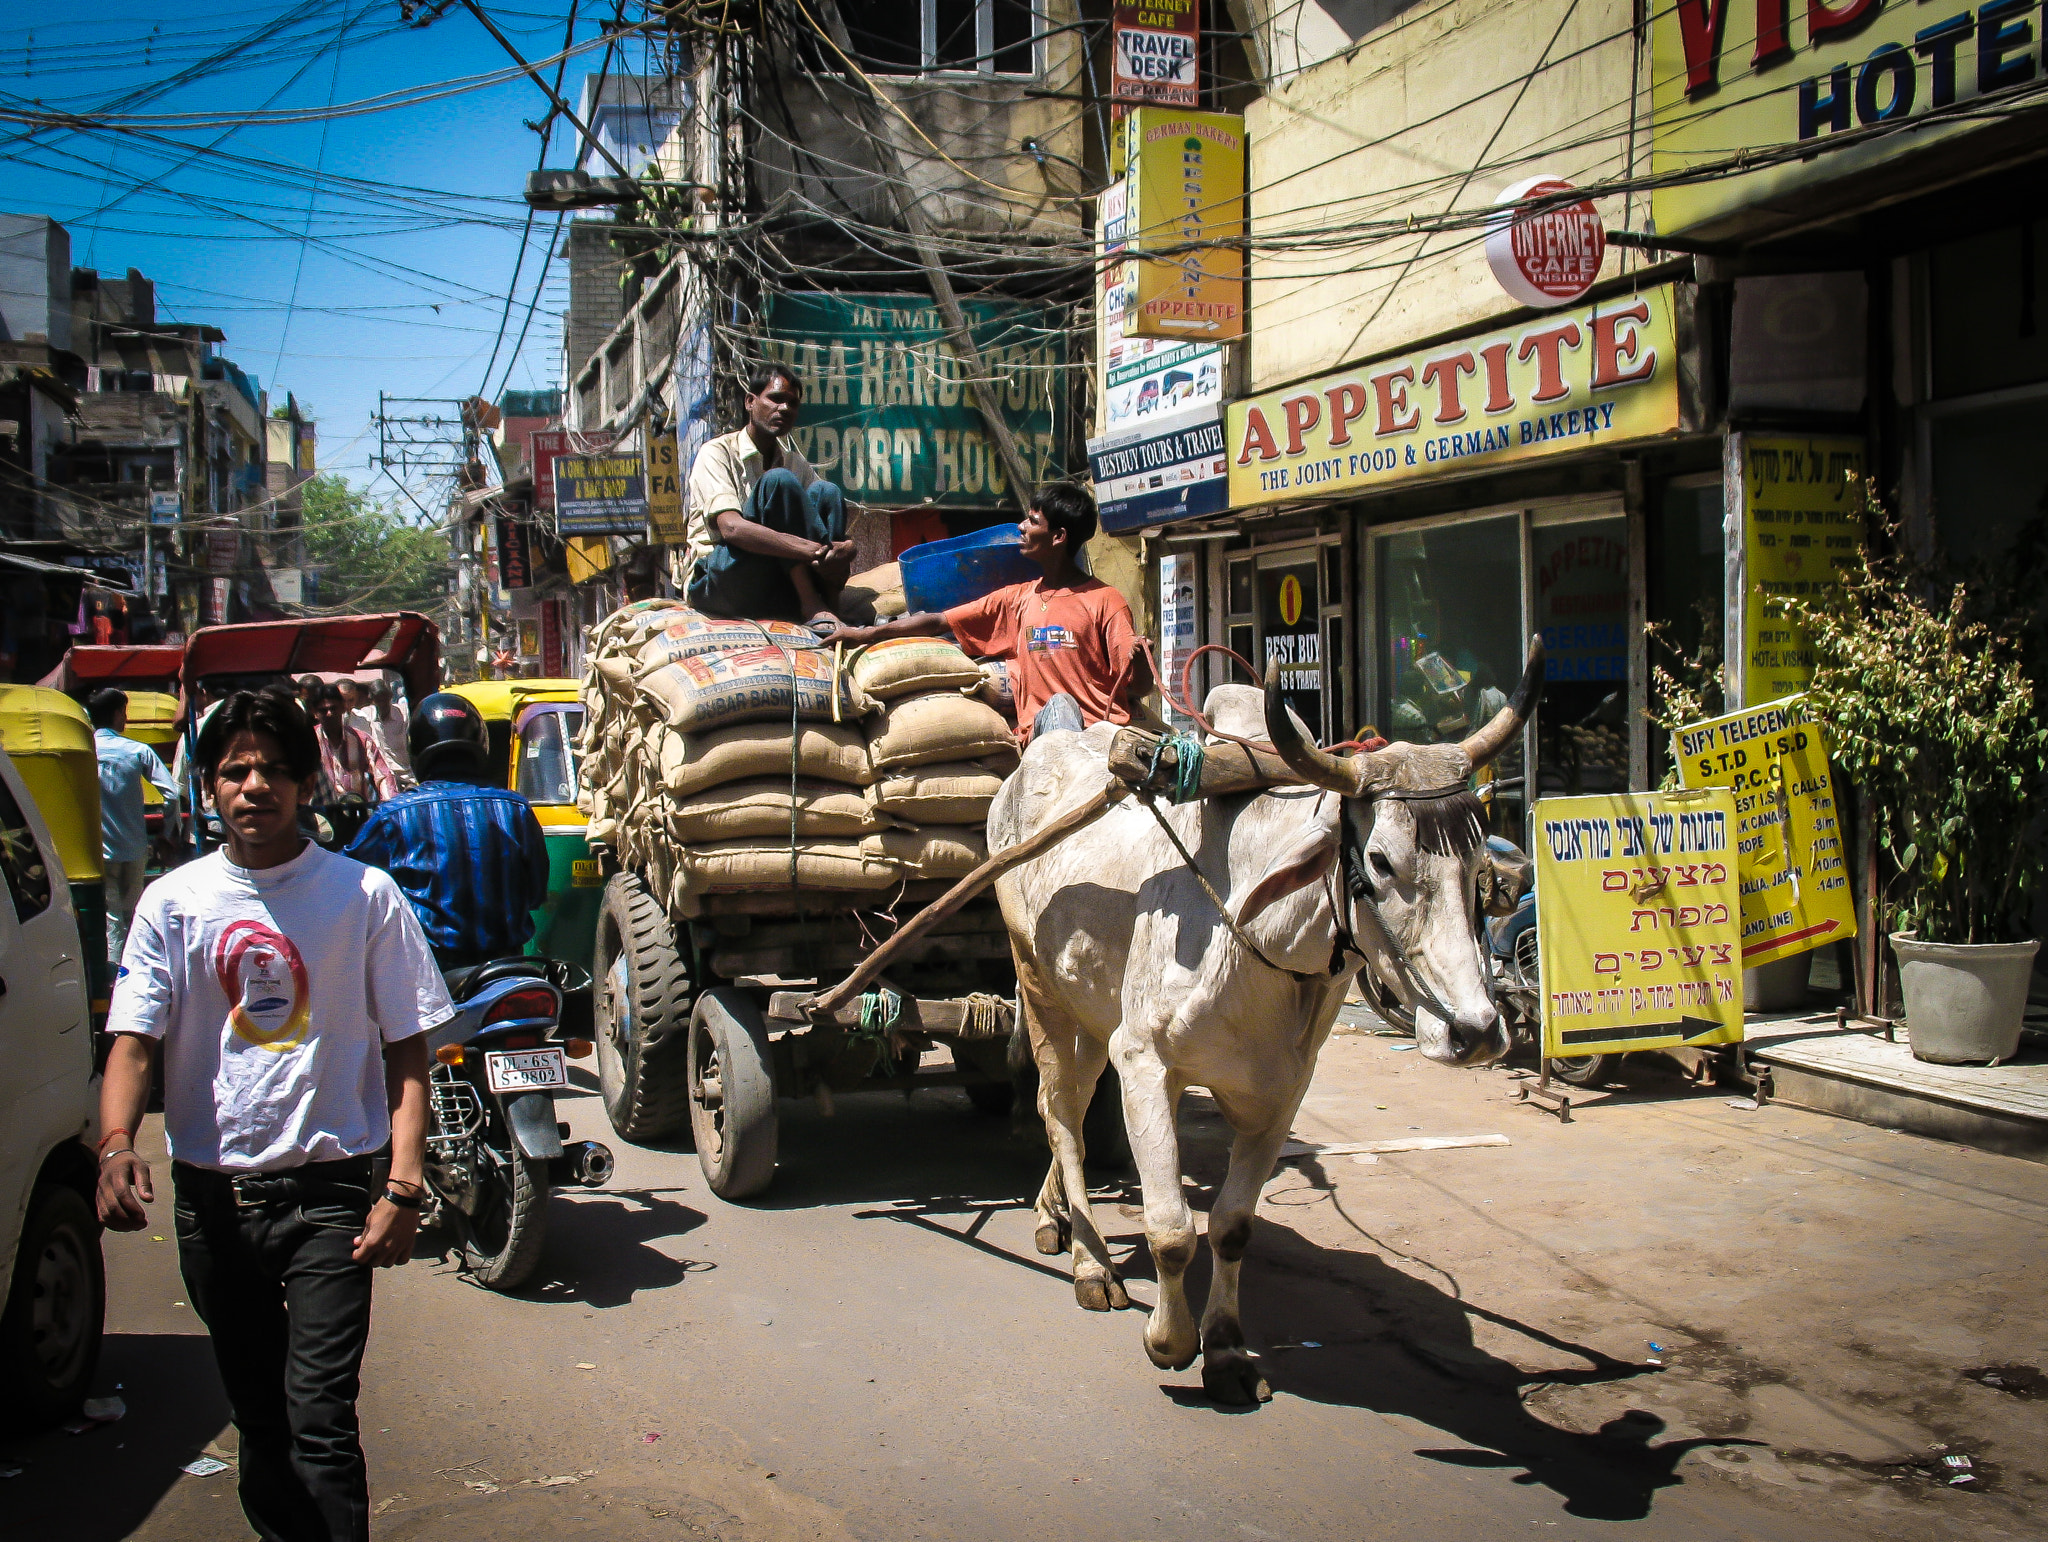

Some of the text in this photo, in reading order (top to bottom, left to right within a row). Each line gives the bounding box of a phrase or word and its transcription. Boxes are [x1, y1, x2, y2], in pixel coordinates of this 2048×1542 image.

[1138, 11, 1175, 29] CAFE
[1119, 31, 1194, 59] TRAVEL
[1131, 54, 1182, 80] DESK
[1799, 0, 2048, 160] HOTE
[1117, 82, 1196, 104] GERMAN
[1145, 121, 1192, 143] GERMAN
[1195, 122, 1239, 151] BAKERY
[1181, 152, 1204, 299] RESTAUANT
[1514, 213, 1601, 258] INTERNET
[1525, 256, 1596, 274] CAFE
[1531, 272, 1592, 284] INSIDE
[1145, 299, 1238, 320] APPETITE
[1236, 299, 1660, 467] APPETITE
[1098, 446, 1140, 479] BESTBUY
[1140, 438, 1174, 471] TOURS
[1174, 436, 1185, 460] &
[1259, 470, 1290, 492] THE
[1294, 457, 1343, 486] JOINT
[1348, 447, 1398, 476] FOOD
[1404, 444, 1418, 467] &
[1424, 424, 1512, 462] GERMAN
[1518, 401, 1617, 447] BAKERY
[1539, 536, 1630, 594] APPETIT
[1265, 633, 1320, 665] BEST BUY
[1751, 650, 1780, 668] HOTEL
[1782, 650, 1816, 668] VISHAL
[815, 693, 849, 713] RIE
[1682, 728, 1715, 757] SIFY
[1699, 732, 1808, 778] S.T.D I.S.D
[1733, 763, 1781, 794] P.C.O
[1792, 774, 1828, 797] CALLS
[1615, 815, 1646, 857] אבי
[1648, 801, 1674, 855] של
[1602, 862, 1728, 892] מצעים
[1772, 866, 1803, 887] JAPN
[1767, 910, 1793, 931] LINE)
[1594, 943, 1733, 974] צעיפים
[1714, 972, 1734, 1003] אל
